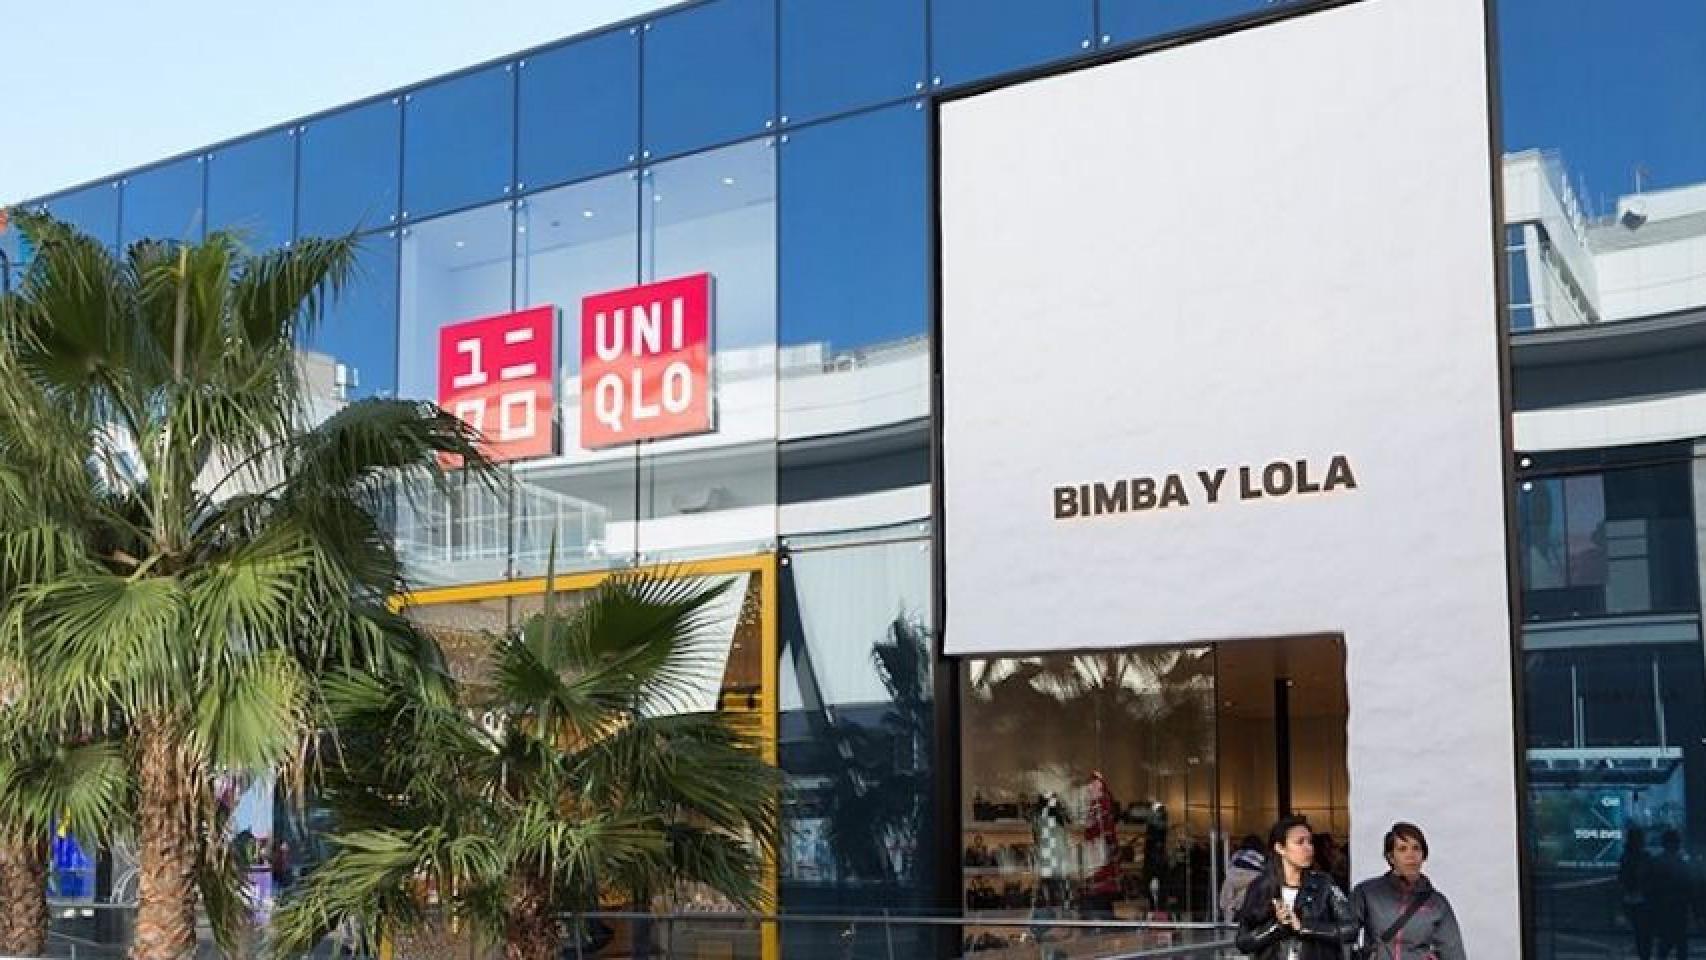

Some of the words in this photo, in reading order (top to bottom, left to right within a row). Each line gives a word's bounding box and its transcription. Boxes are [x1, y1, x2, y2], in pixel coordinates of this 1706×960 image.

[453, 327, 536, 388] ユニ
[595, 297, 683, 361] UNI
[595, 361, 692, 432] QLO
[1053, 474, 1189, 519] BIMBA
[1197, 468, 1226, 502] Y
[1239, 455, 1357, 500] LOLA
